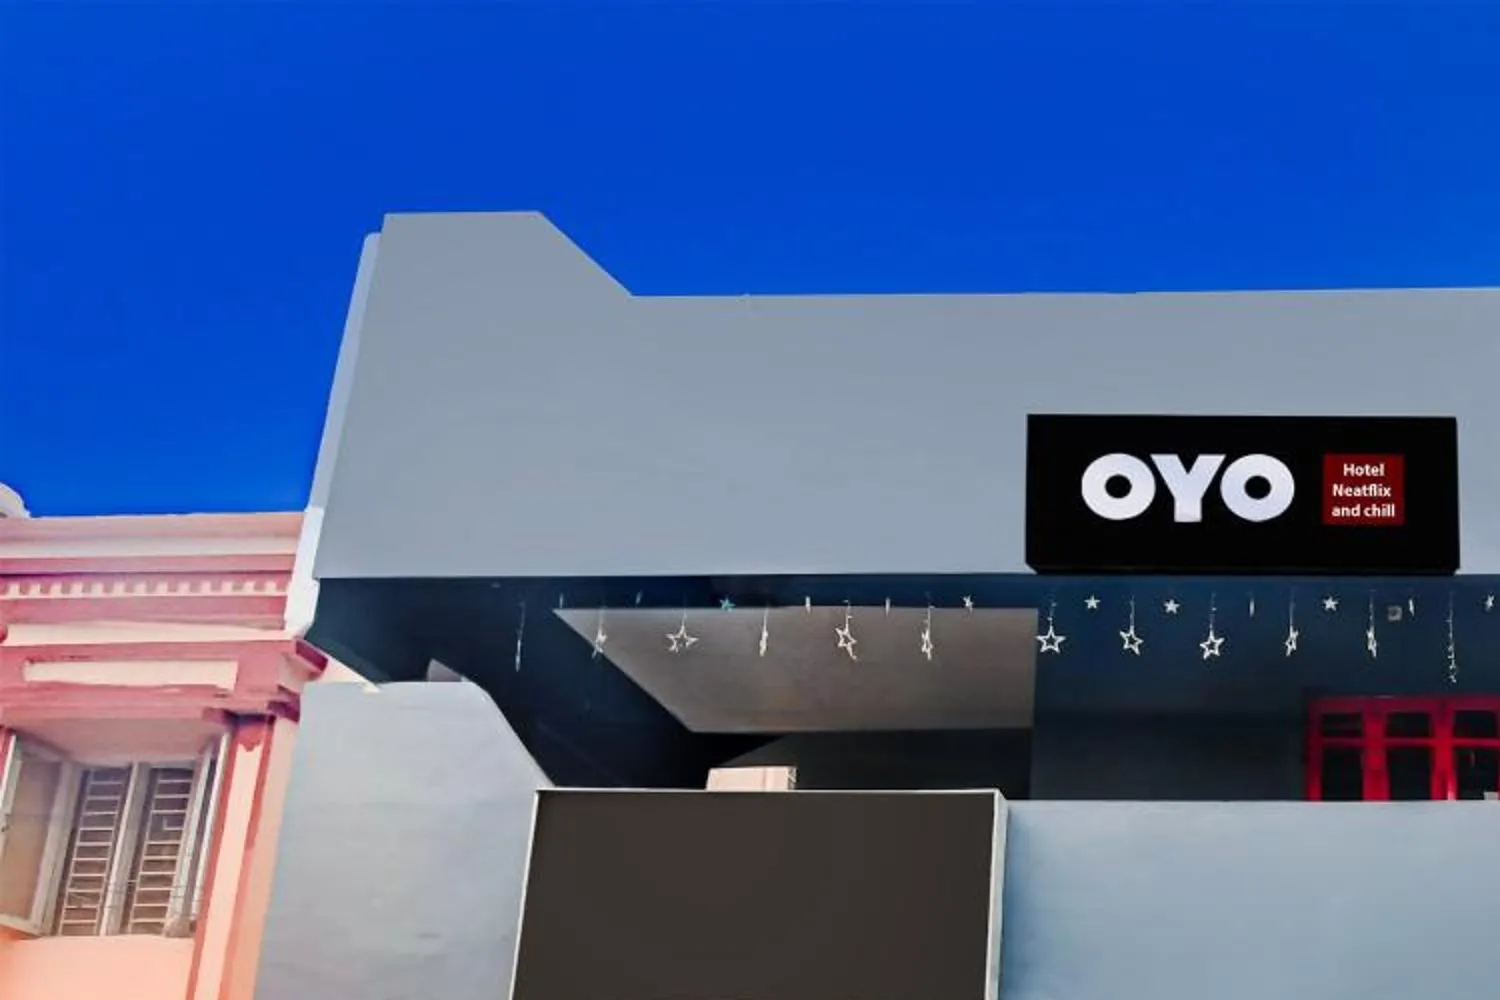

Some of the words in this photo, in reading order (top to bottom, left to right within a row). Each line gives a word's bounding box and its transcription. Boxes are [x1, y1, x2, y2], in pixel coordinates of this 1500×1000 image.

[1343, 463, 1385, 477] Hotel
[1081, 453, 1295, 522] OYO
[1332, 483, 1391, 497] Neatflix
[1331, 503, 1360, 517] and
[1363, 503, 1395, 518] chill
